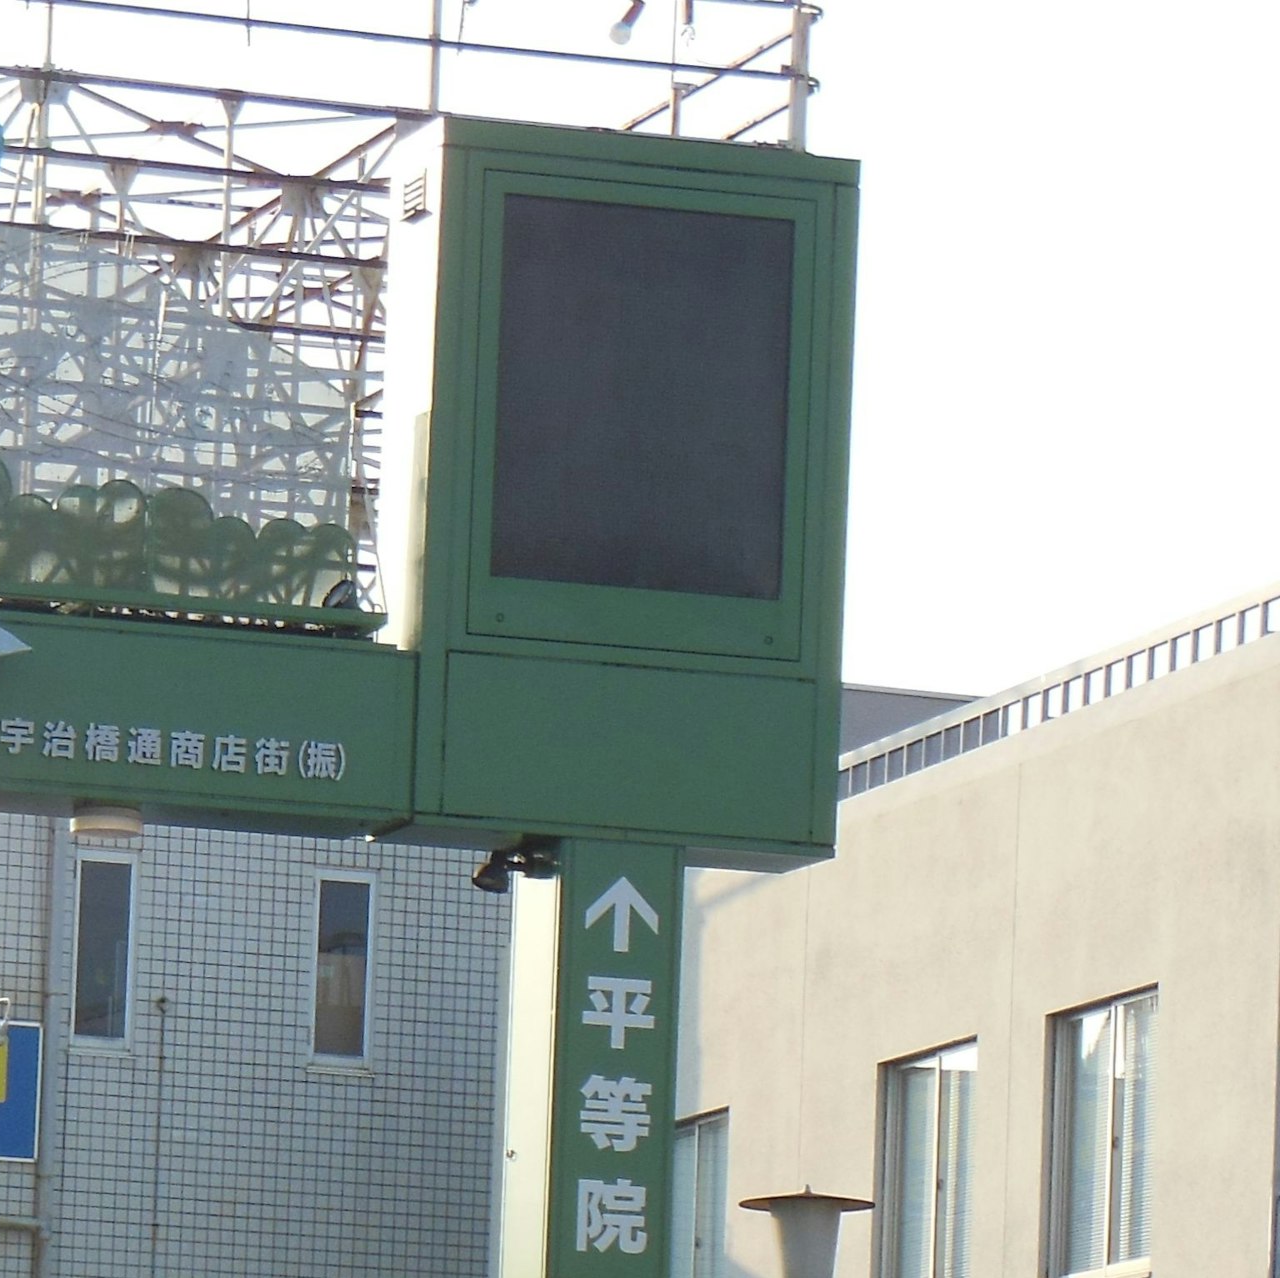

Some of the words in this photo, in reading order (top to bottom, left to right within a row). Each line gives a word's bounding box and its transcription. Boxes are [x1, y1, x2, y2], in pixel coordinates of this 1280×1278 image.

[0, 717, 347, 782] 宇治橋通商店街(振)
[575, 975, 656, 1256] 平等院
